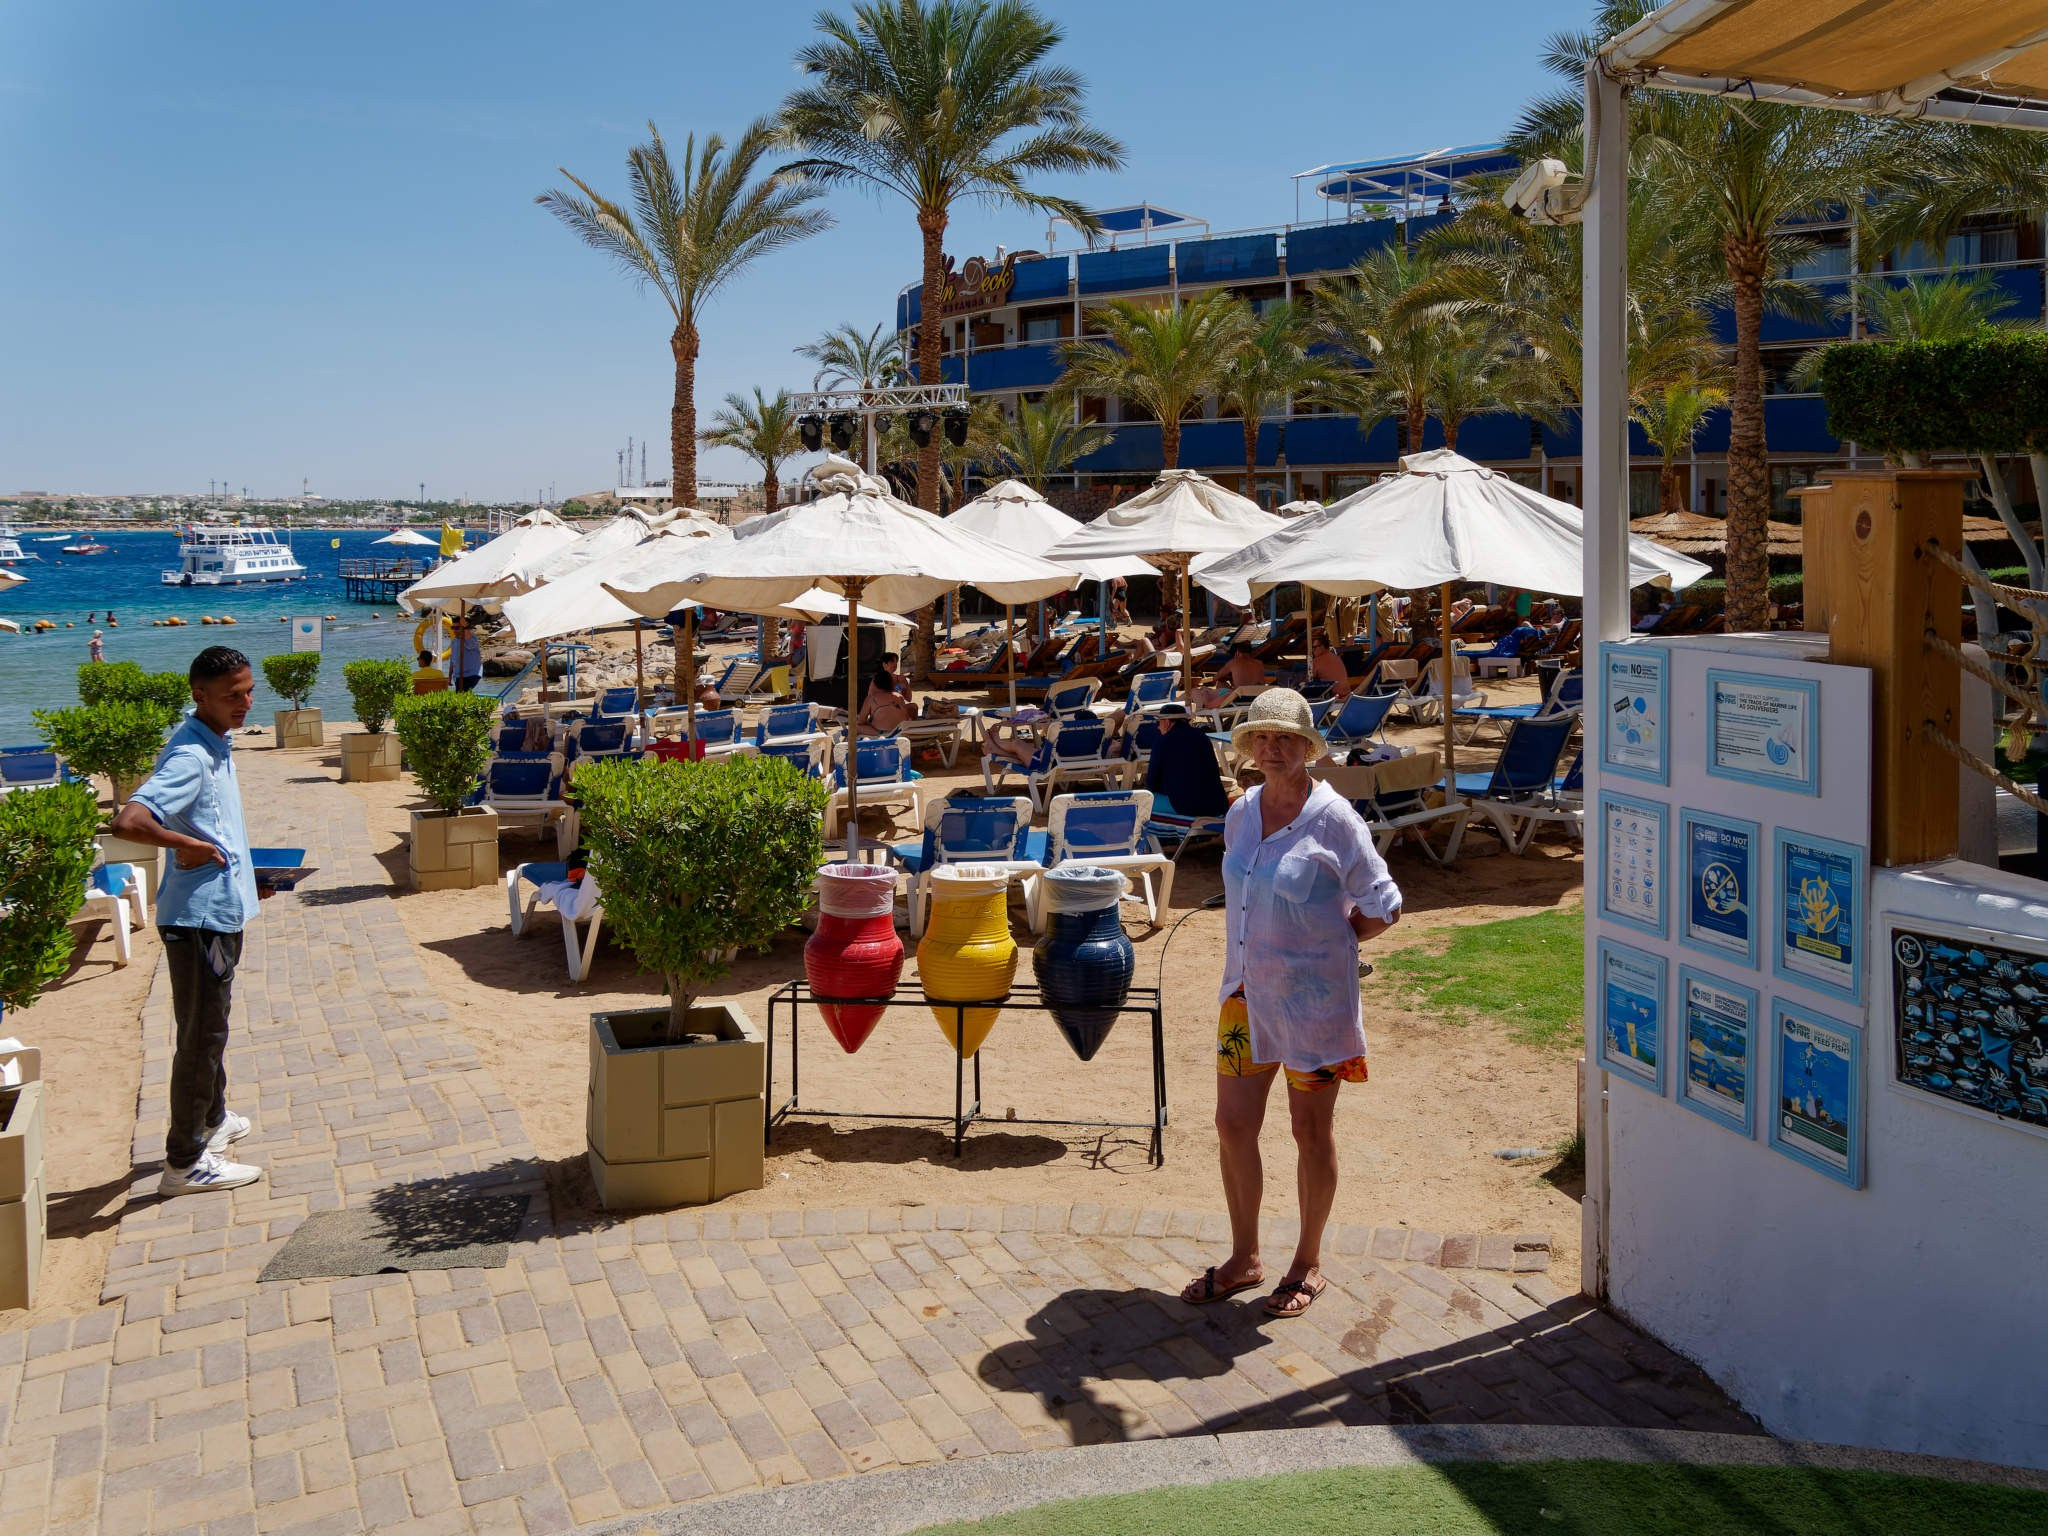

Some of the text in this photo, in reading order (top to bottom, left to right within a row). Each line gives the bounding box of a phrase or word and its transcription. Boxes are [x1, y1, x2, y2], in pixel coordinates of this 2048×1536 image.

[1631, 664, 1642, 675] NO
[1770, 702, 1787, 710] MARINE
[1721, 833, 1747, 845] DO NOT
[1797, 1029, 1810, 1040] FINS
[1814, 1035, 1830, 1047] FEED
